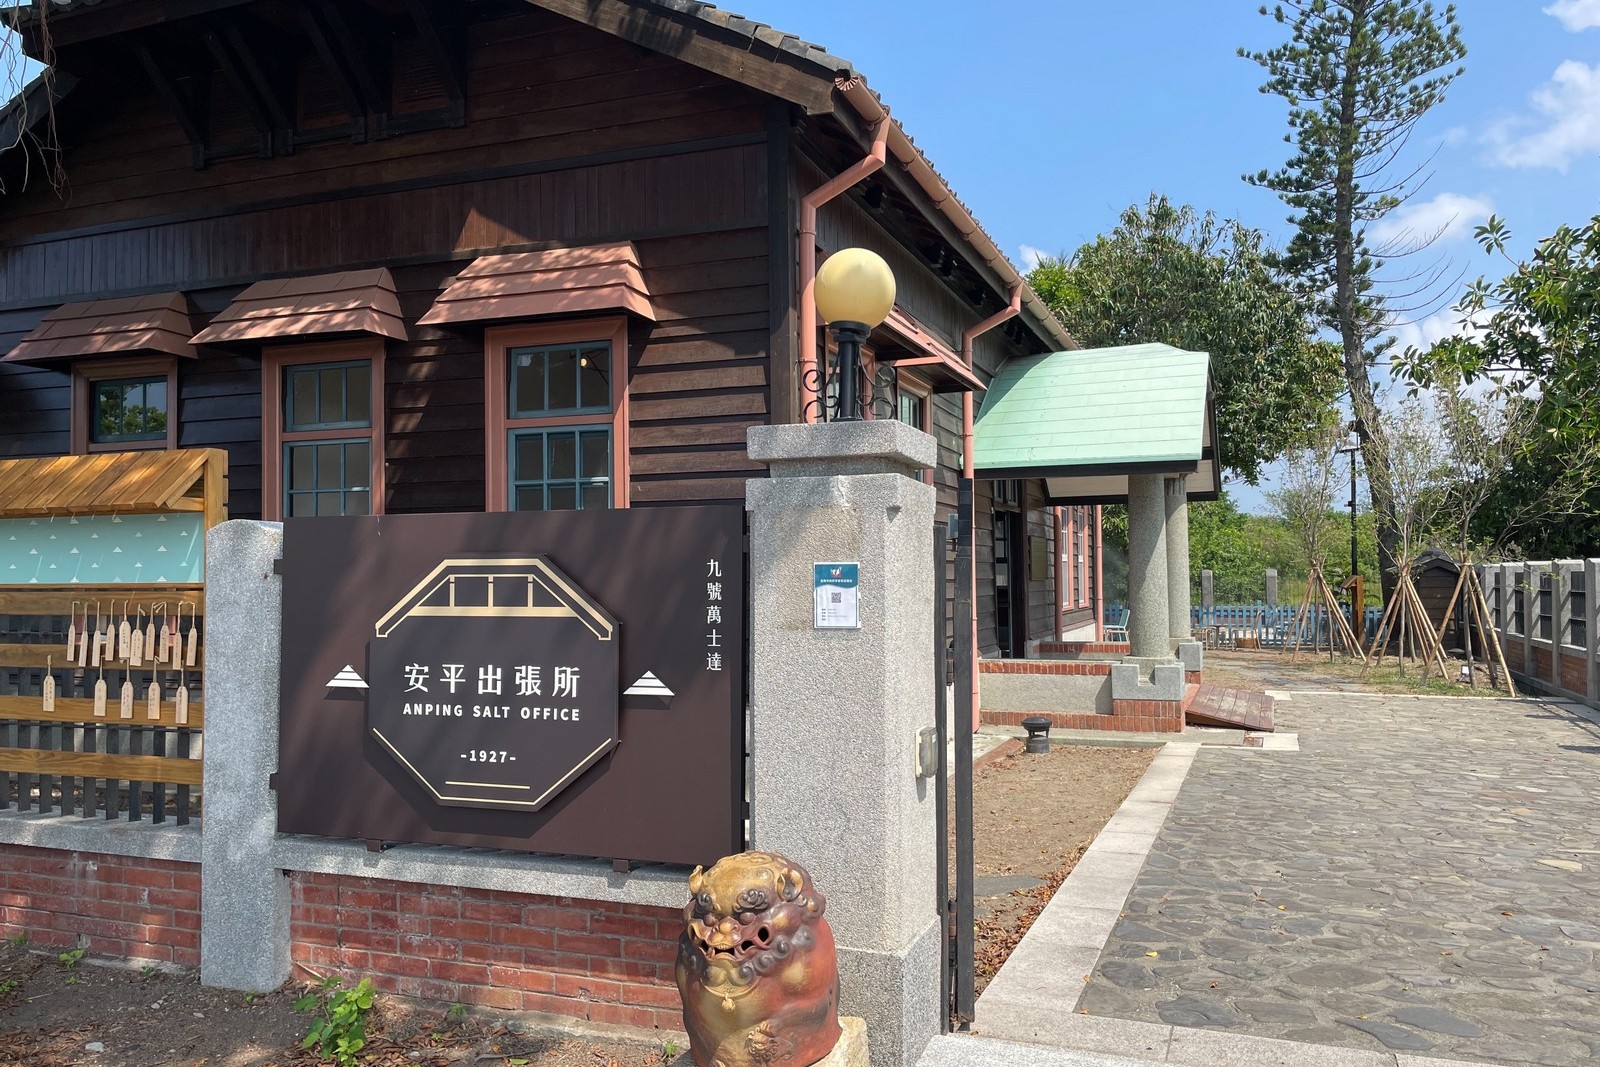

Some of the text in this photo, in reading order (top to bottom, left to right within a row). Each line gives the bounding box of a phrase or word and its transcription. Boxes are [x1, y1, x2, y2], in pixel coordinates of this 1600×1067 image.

[706, 558, 722, 672] 九號萬士達
[403, 662, 580, 698] 安平出張所
[403, 702, 580, 721] ANPING SALT OFFICE
